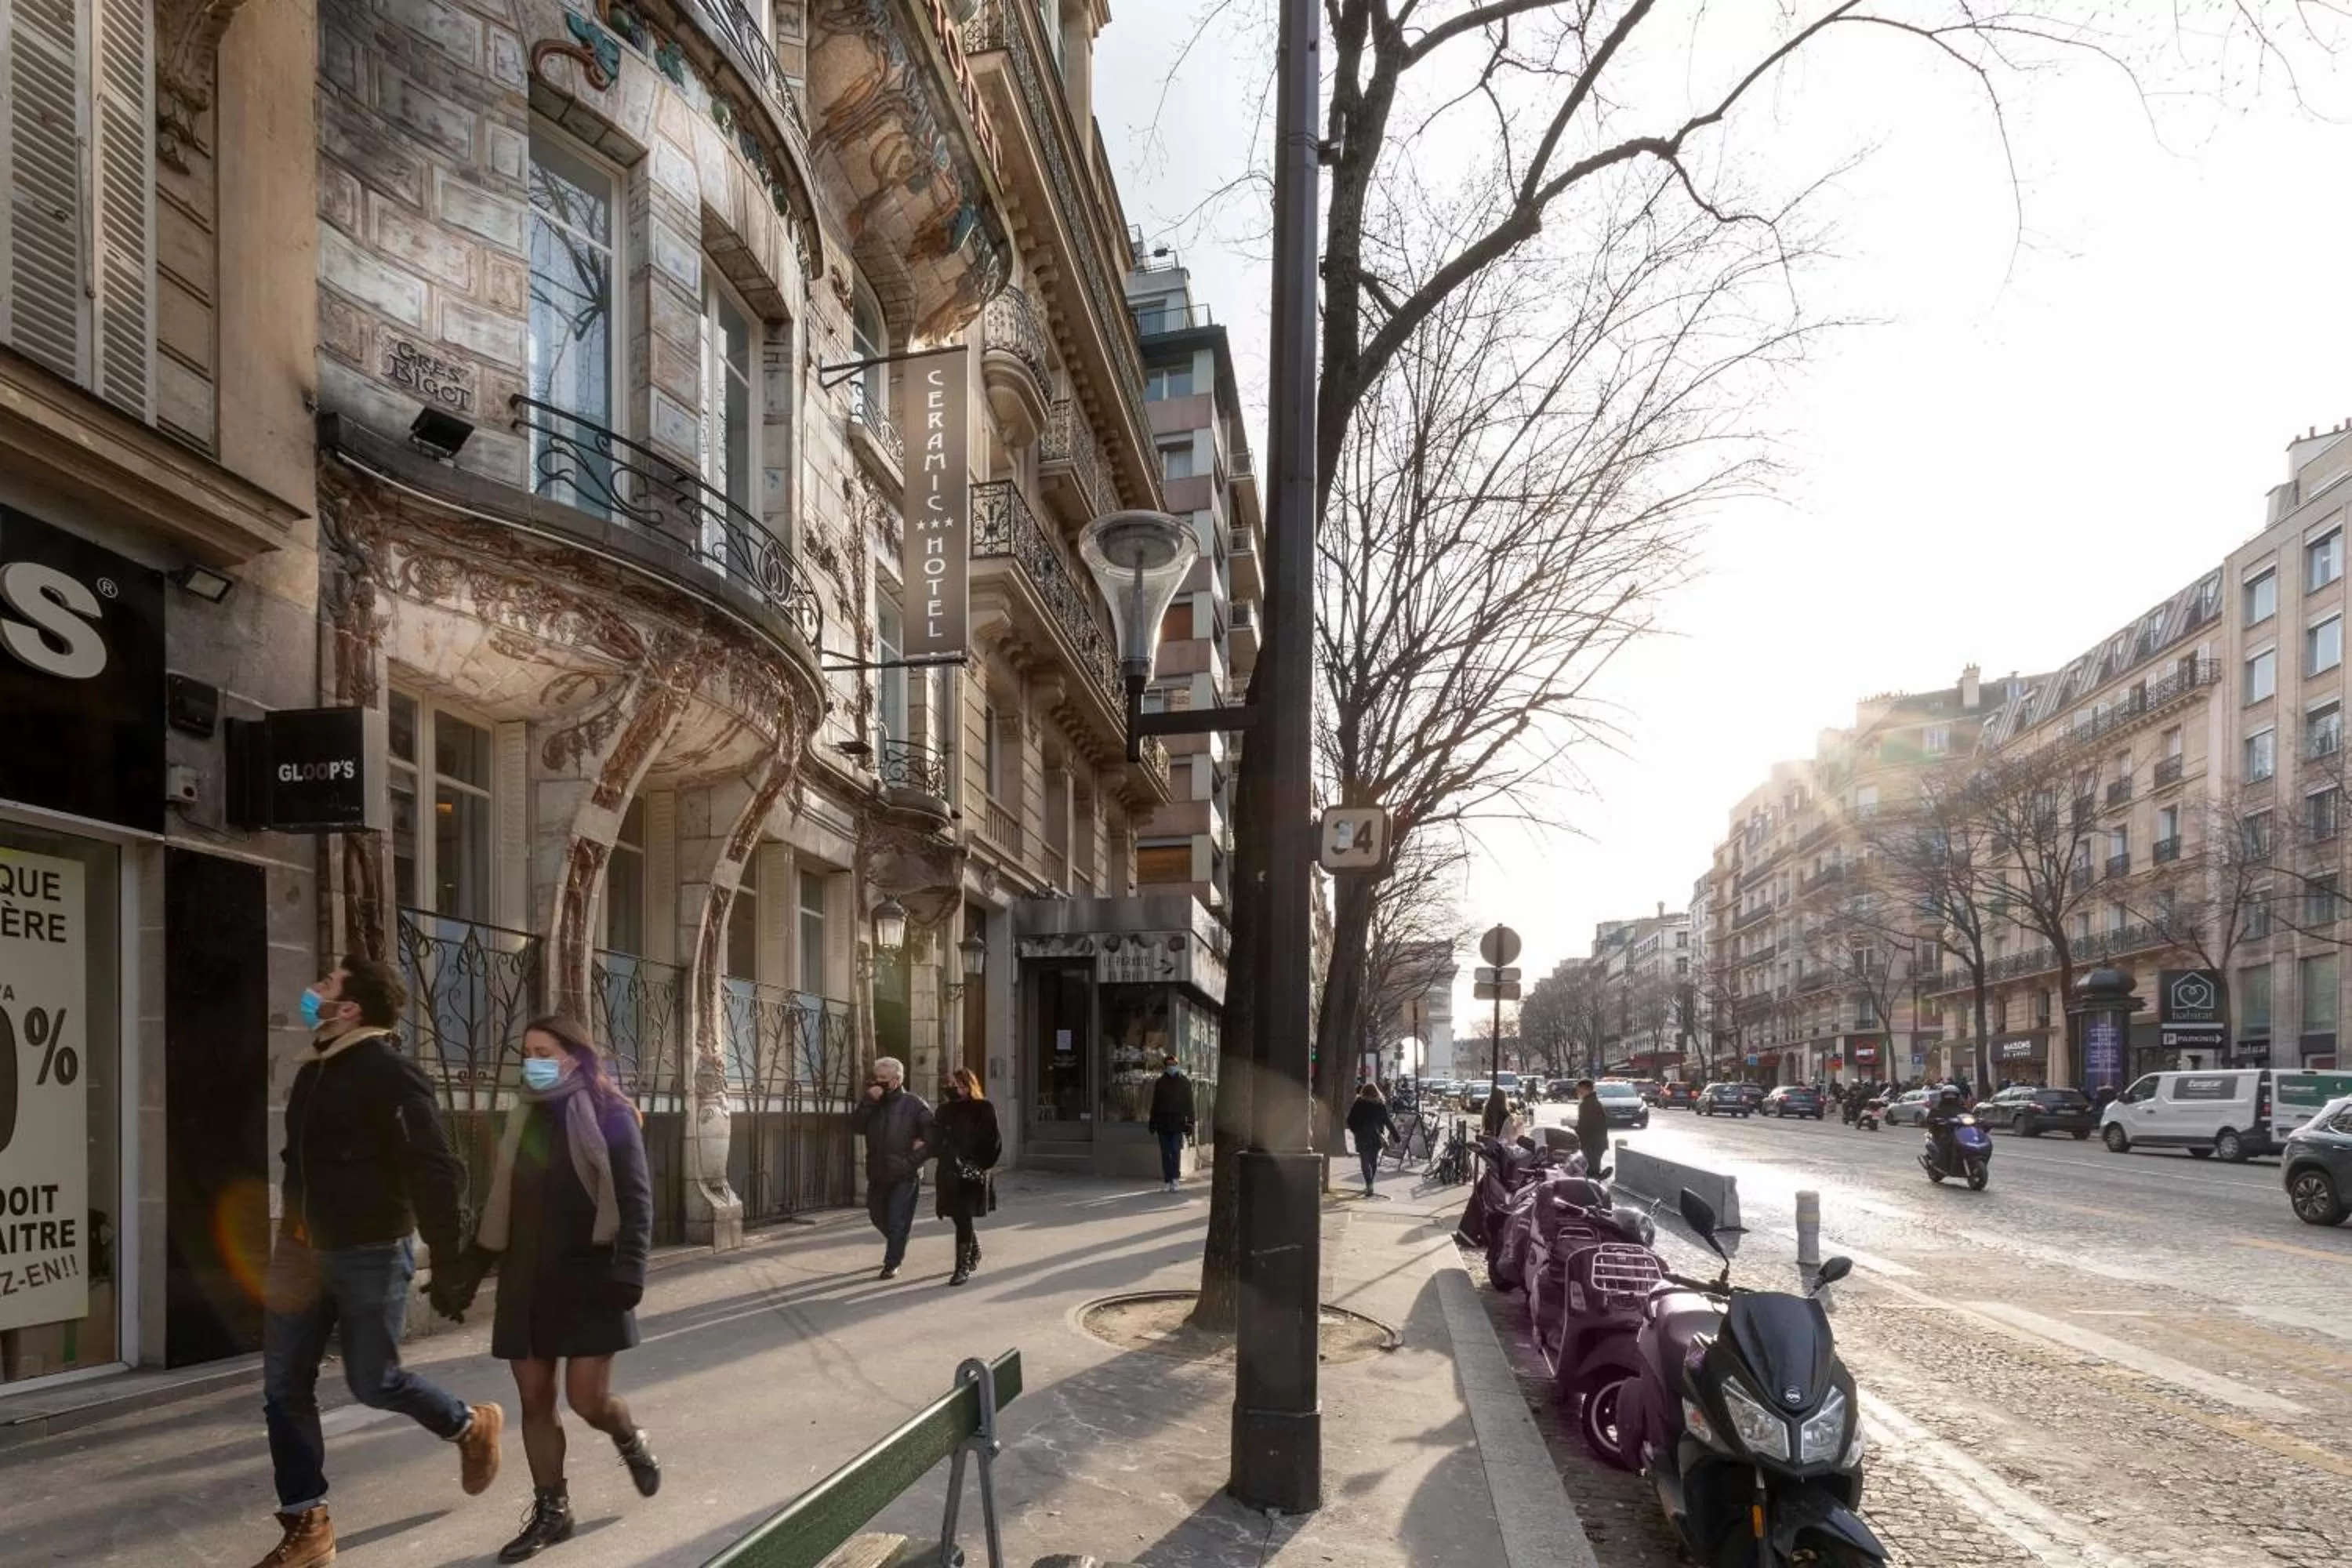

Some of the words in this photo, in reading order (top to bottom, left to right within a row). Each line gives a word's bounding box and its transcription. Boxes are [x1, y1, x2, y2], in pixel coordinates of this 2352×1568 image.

[924, 369, 946, 511] CERAMIC
[924, 537, 946, 638] HOTEL
[278, 760, 355, 782] GLOOP'S
[0, 864, 61, 902] QUE
[2, 900, 67, 943] ÈRE
